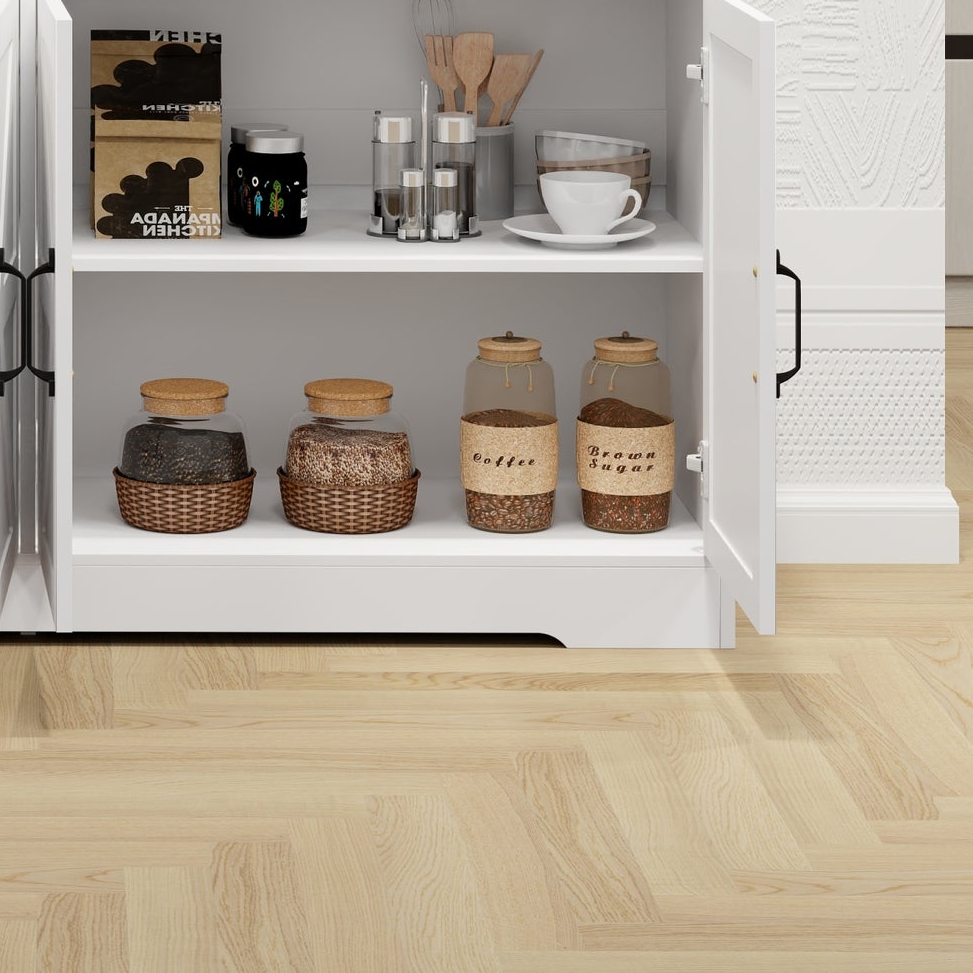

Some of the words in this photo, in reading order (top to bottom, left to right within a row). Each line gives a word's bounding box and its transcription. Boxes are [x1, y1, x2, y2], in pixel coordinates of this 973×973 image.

[472, 452, 536, 467] Coffee
[587, 445, 657, 460] Brown
[588, 459, 655, 474] Sugar
